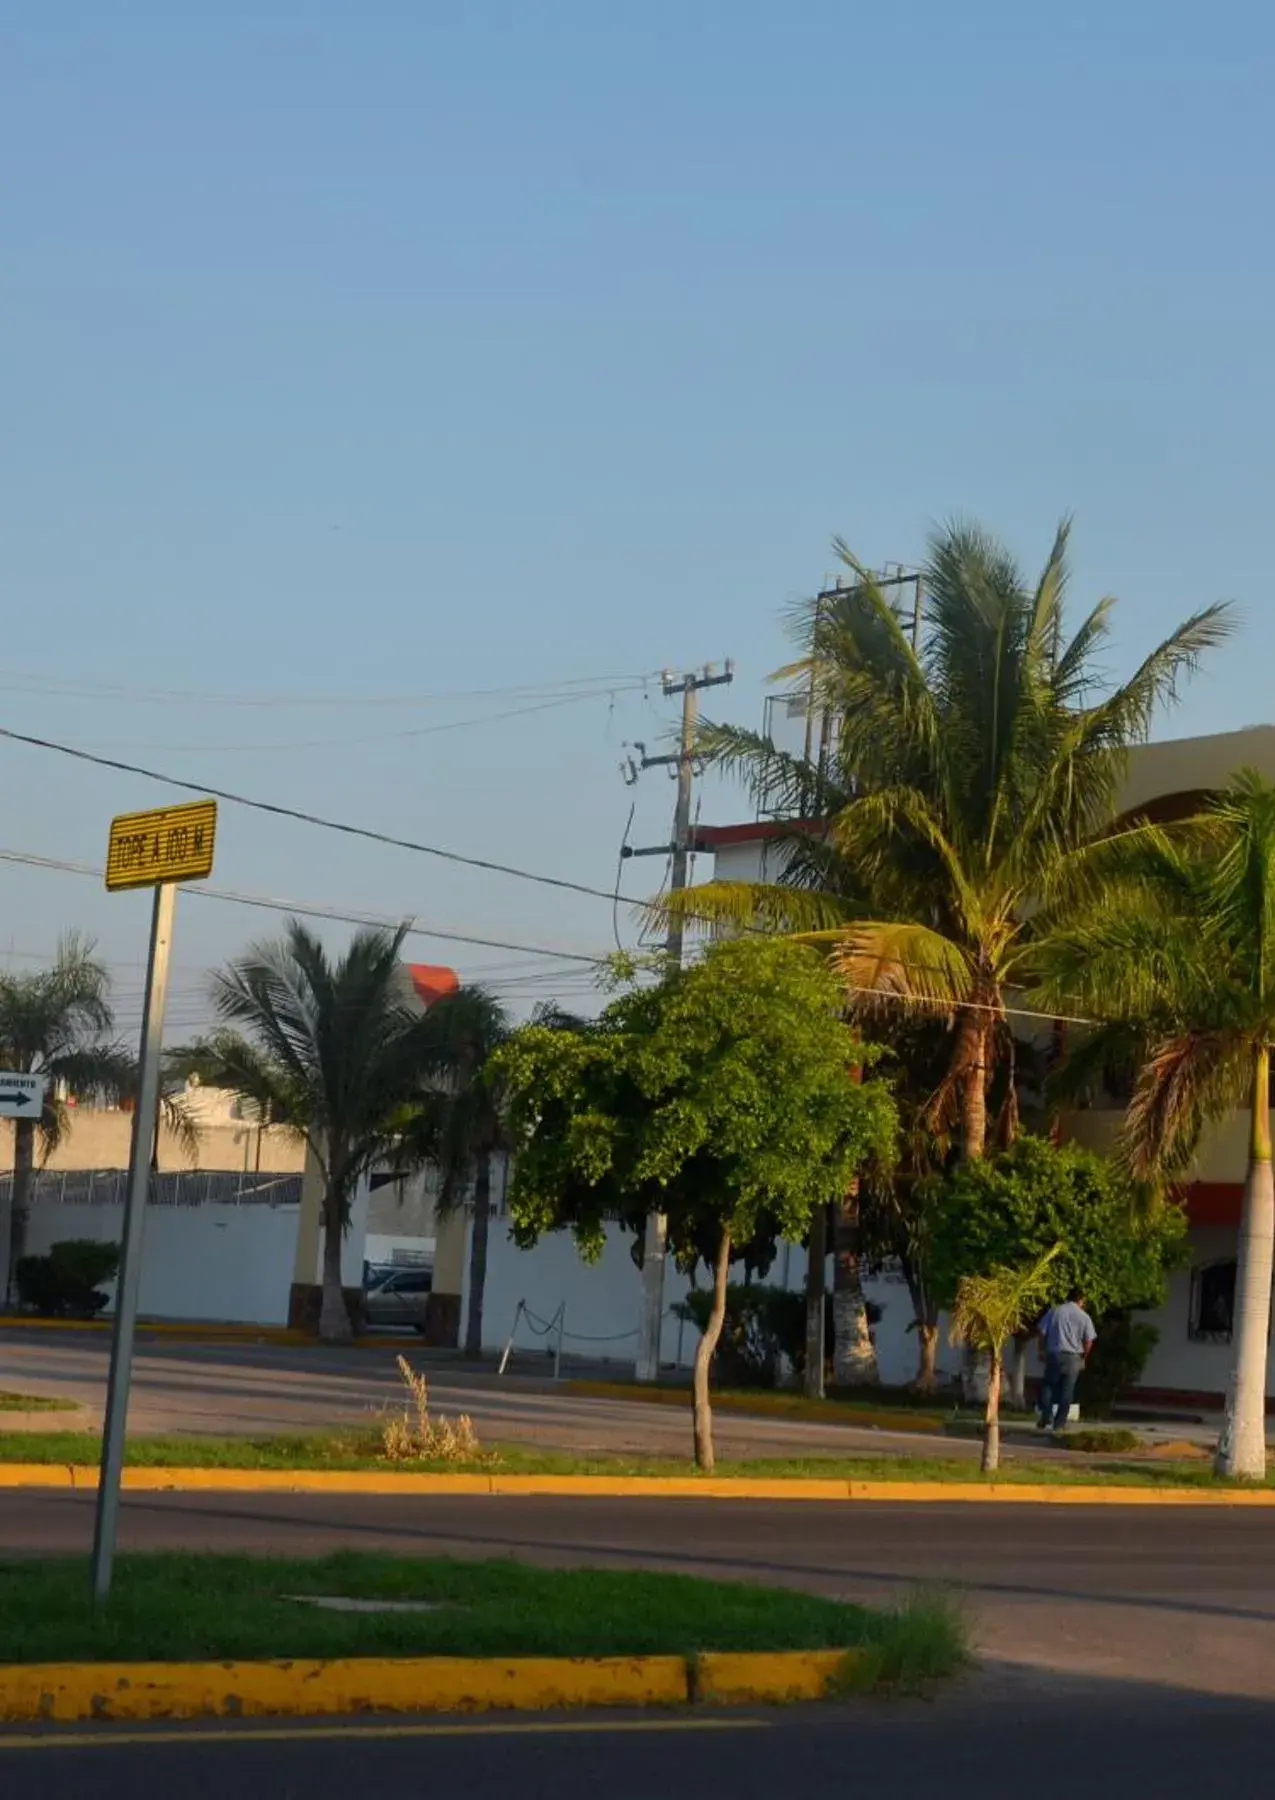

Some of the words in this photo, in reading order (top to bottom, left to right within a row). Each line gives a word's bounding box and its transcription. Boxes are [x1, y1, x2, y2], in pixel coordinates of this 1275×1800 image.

[117, 833, 147, 868] TOPE
[151, 831, 160, 862] A
[166, 825, 188, 861] 100
